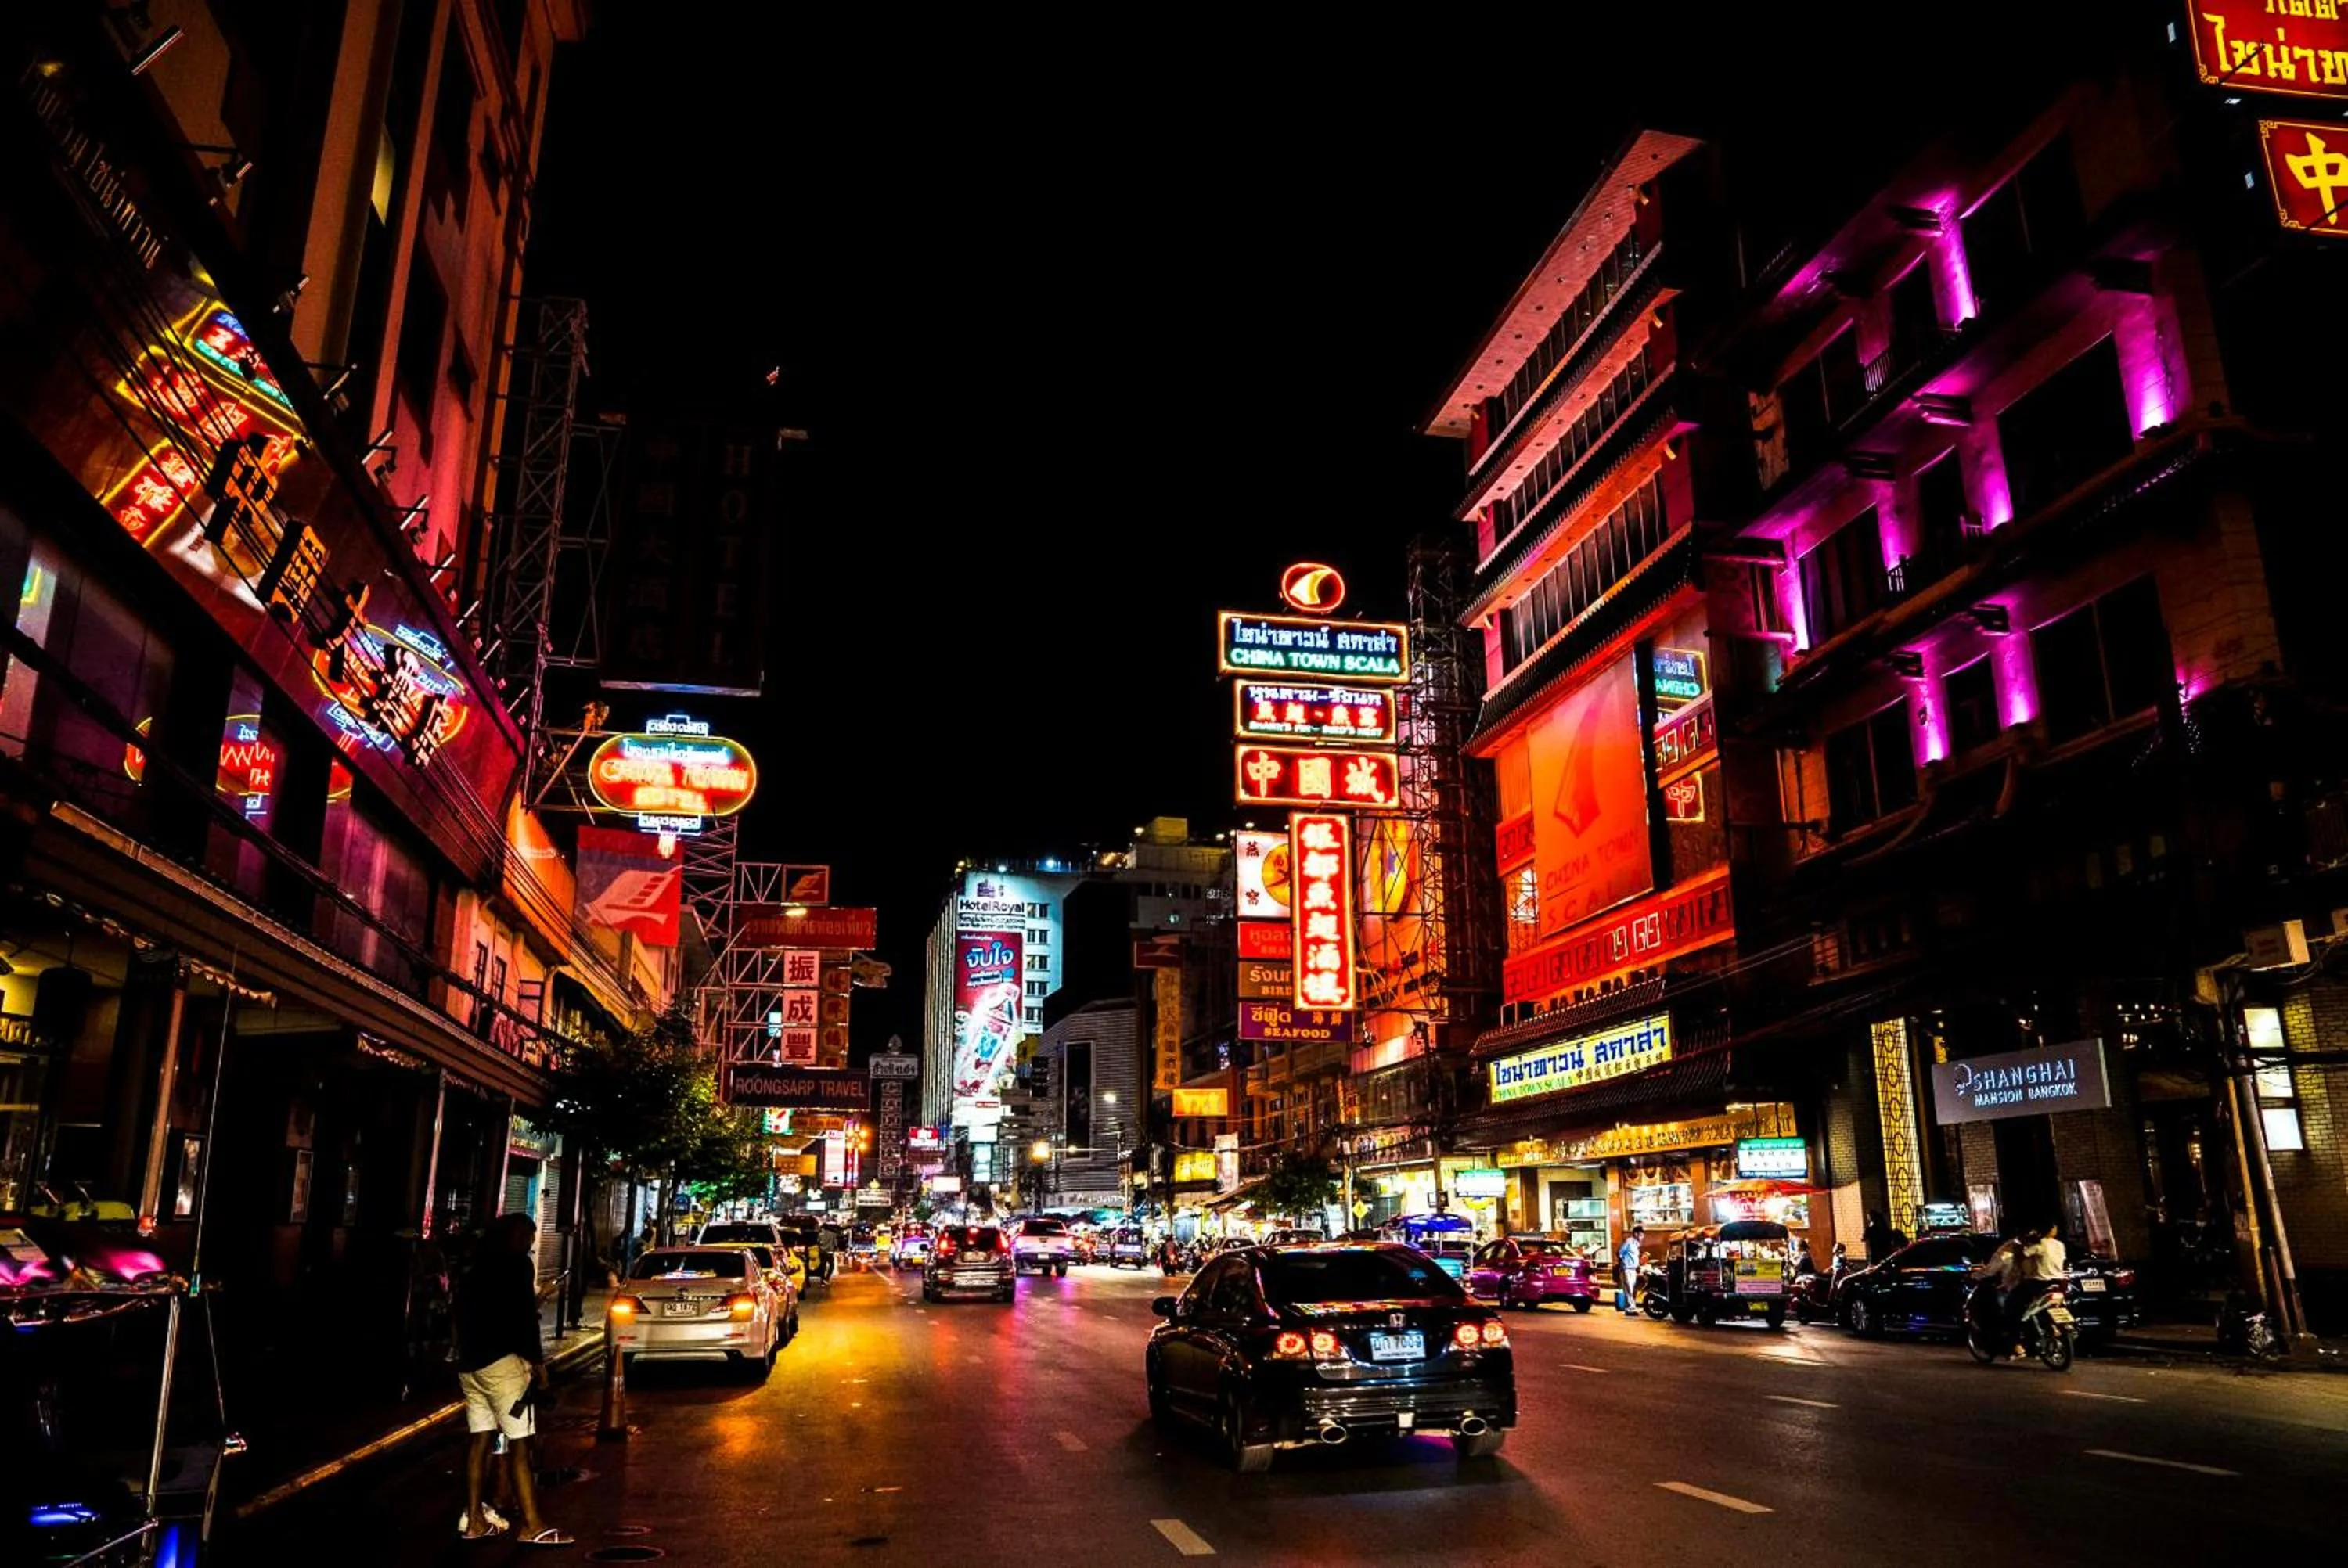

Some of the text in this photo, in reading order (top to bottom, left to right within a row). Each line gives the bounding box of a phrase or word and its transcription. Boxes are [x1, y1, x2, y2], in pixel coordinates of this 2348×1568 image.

[1230, 649, 1400, 674] CHINA TOWN SCALA
[600, 758, 749, 792] CHINA TOWN
[1546, 828, 1640, 891] CHINA TOWN
[1263, 1027, 1331, 1039] SEAFOOD
[1493, 1019, 1666, 1085] ไชน่าทาวน์ สกาล่า
[735, 1077, 865, 1097] ROONGSARP TRAVEL
[1973, 1059, 2076, 1091] SHANGHAI
[1975, 1082, 2078, 1107] MANSION BANGKOK
